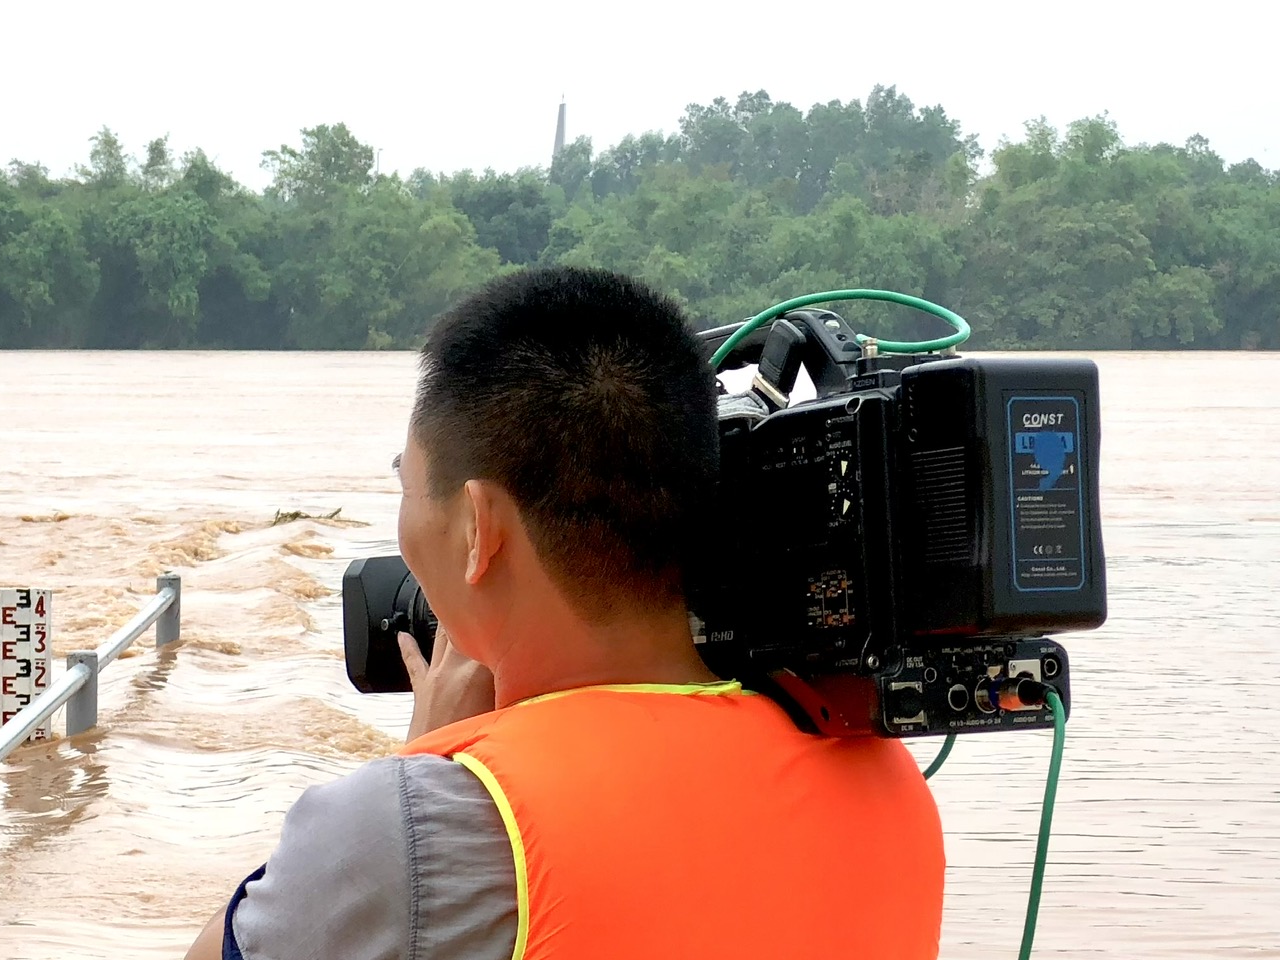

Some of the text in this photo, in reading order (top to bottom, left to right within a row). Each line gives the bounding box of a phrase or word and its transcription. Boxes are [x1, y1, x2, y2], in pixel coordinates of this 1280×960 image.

[1023, 413, 1064, 428] CONST
[34, 595, 46, 618] 4
[34, 630, 46, 653] 3
[34, 665, 46, 688] 2
